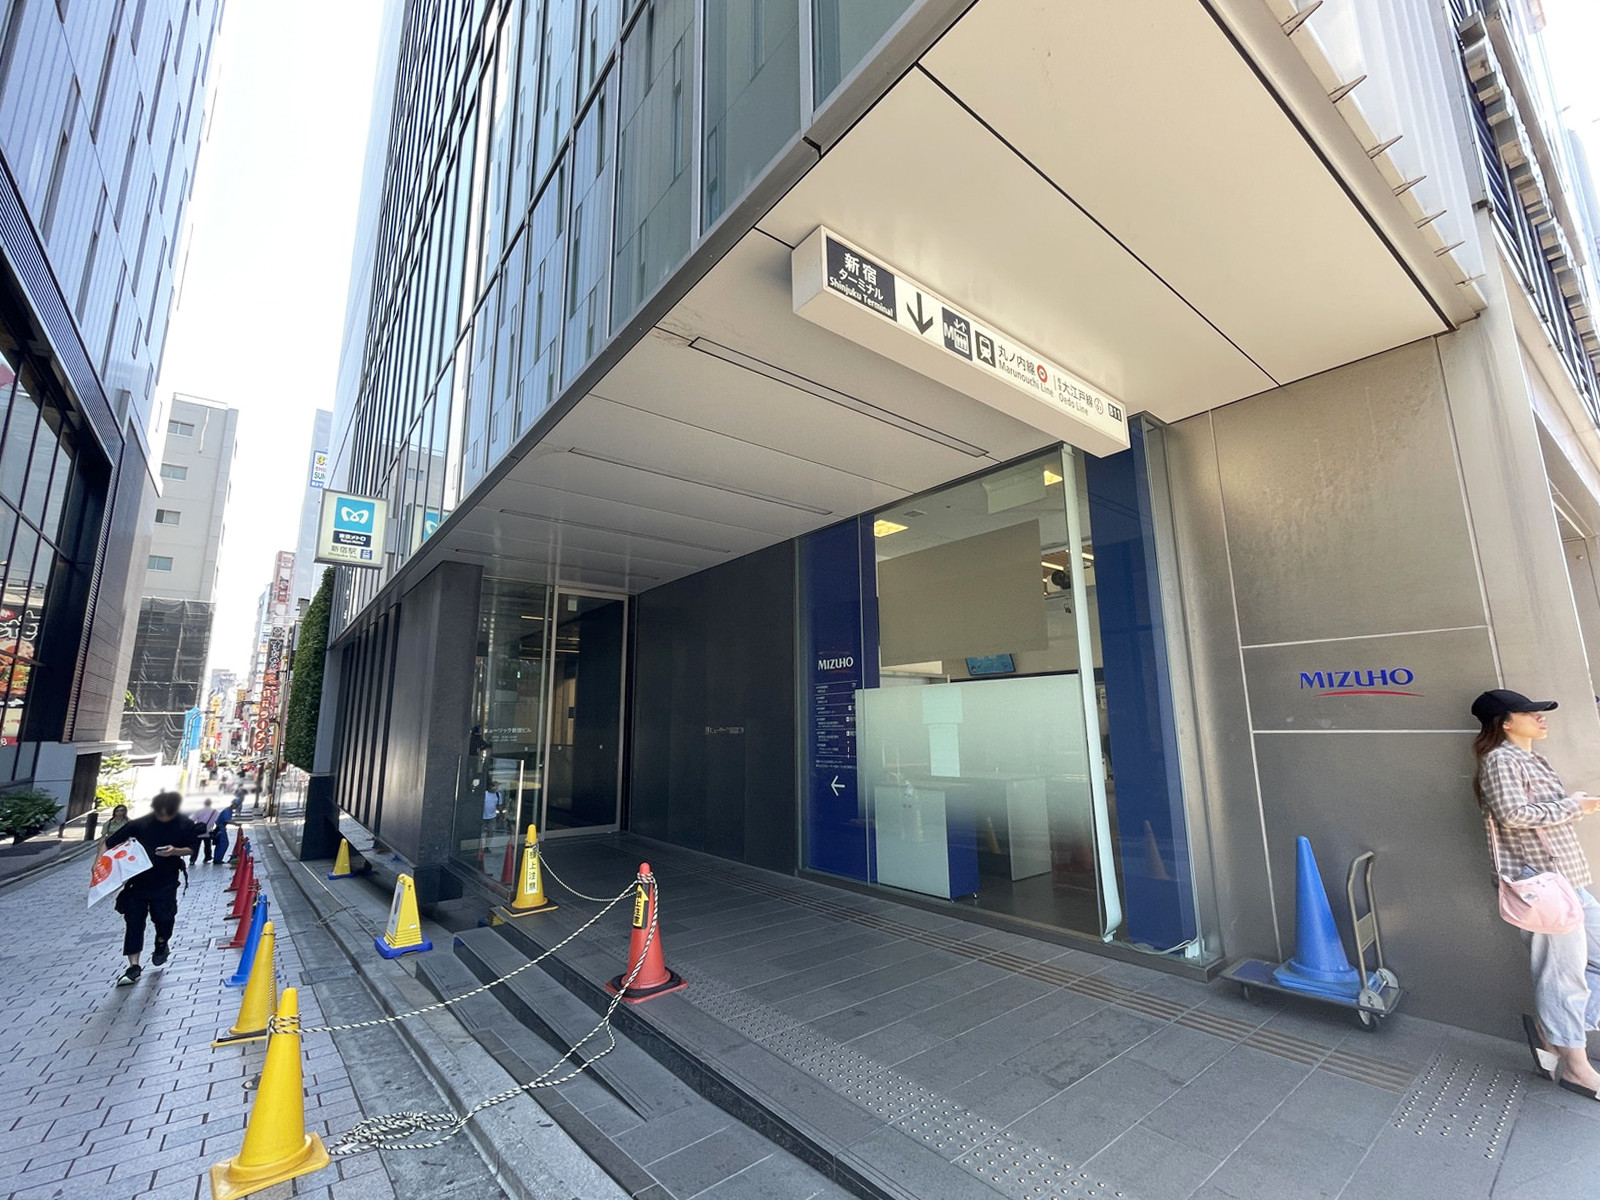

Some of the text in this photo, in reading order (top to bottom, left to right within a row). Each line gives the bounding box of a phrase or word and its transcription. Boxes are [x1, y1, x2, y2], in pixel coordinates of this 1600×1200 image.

[839, 268, 884, 300] ターミナル
[844, 253, 877, 286] 新宿
[829, 276, 894, 317] Shinjuku Terminal
[997, 344, 1036, 377] 丸ノ内線
[998, 359, 1040, 390] Marunouchi
[1040, 382, 1054, 398] Line
[1058, 392, 1075, 409] Oedo
[1075, 401, 1089, 417] Line
[817, 656, 854, 671] MIZUHO
[1299, 667, 1415, 690] MIZUHO
